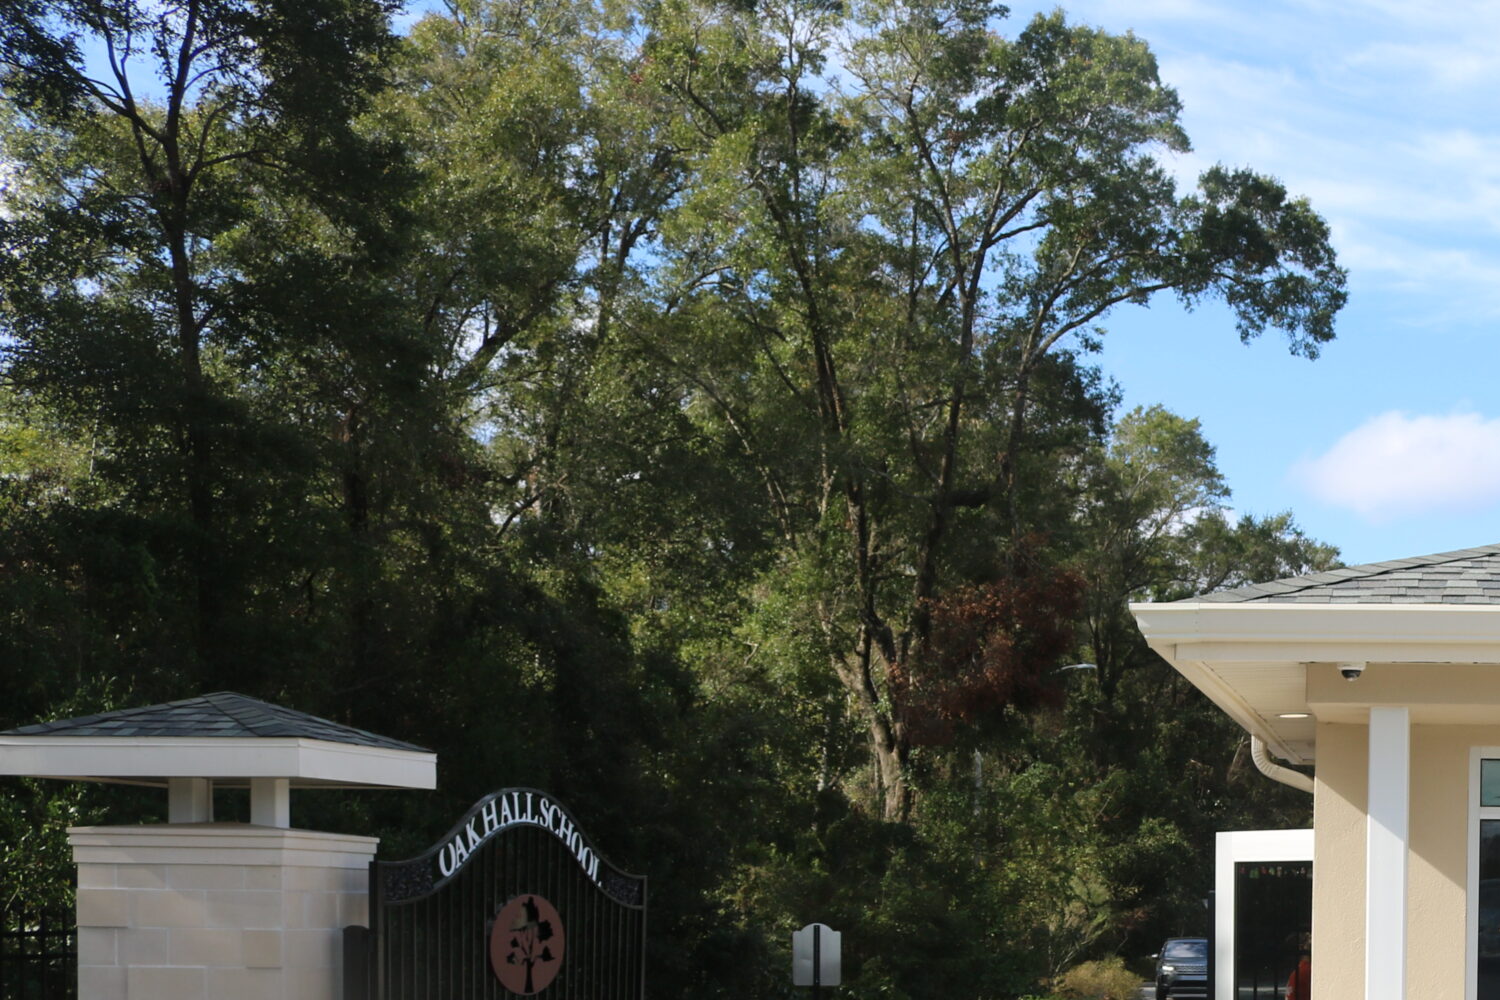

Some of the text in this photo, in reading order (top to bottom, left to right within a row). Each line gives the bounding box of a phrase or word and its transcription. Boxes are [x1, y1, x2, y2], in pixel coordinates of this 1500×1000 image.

[439, 791, 602, 887] OAK HALL SCHOOL
